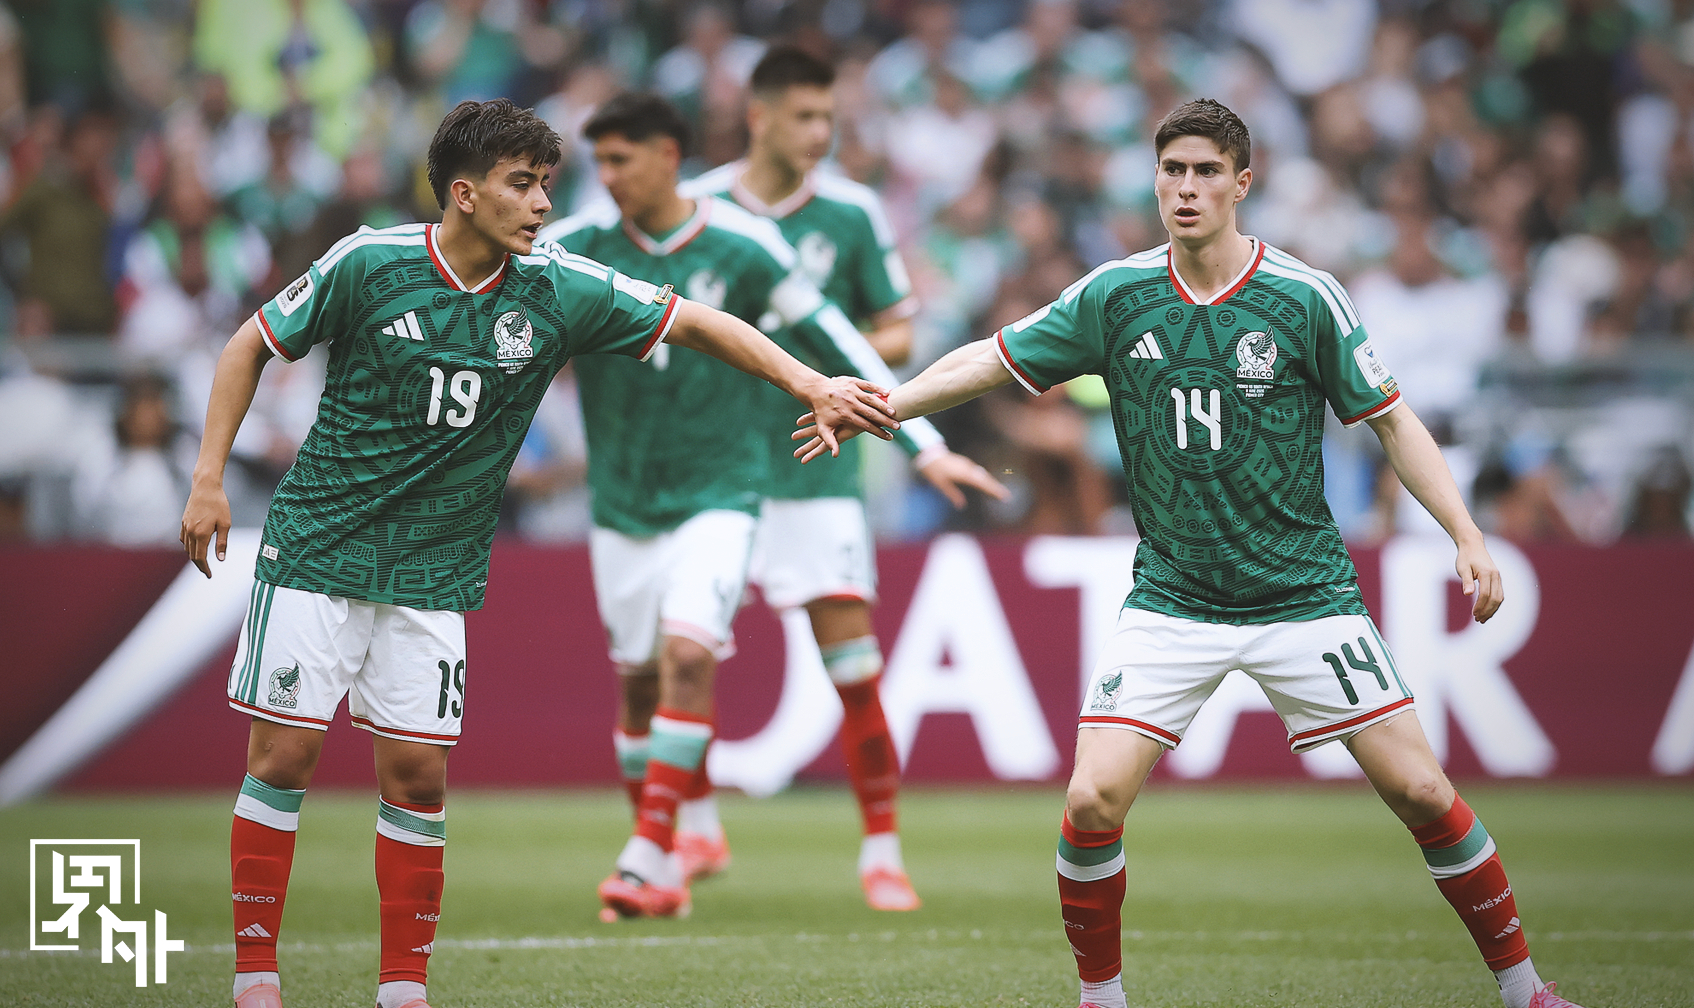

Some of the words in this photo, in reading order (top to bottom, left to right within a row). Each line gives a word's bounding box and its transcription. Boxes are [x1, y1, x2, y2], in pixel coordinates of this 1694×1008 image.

[498, 349, 532, 358] MÉXICO
[1237, 368, 1273, 378] MÉXICO
[426, 366, 482, 428] 19
[1170, 387, 1222, 451] 14
[437, 659, 465, 719] 19
[703, 535, 1557, 795] ATR
[1322, 636, 1389, 706] 14
[231, 891, 276, 904] MÉXICO
[1472, 883, 1512, 912] MÉXIC
